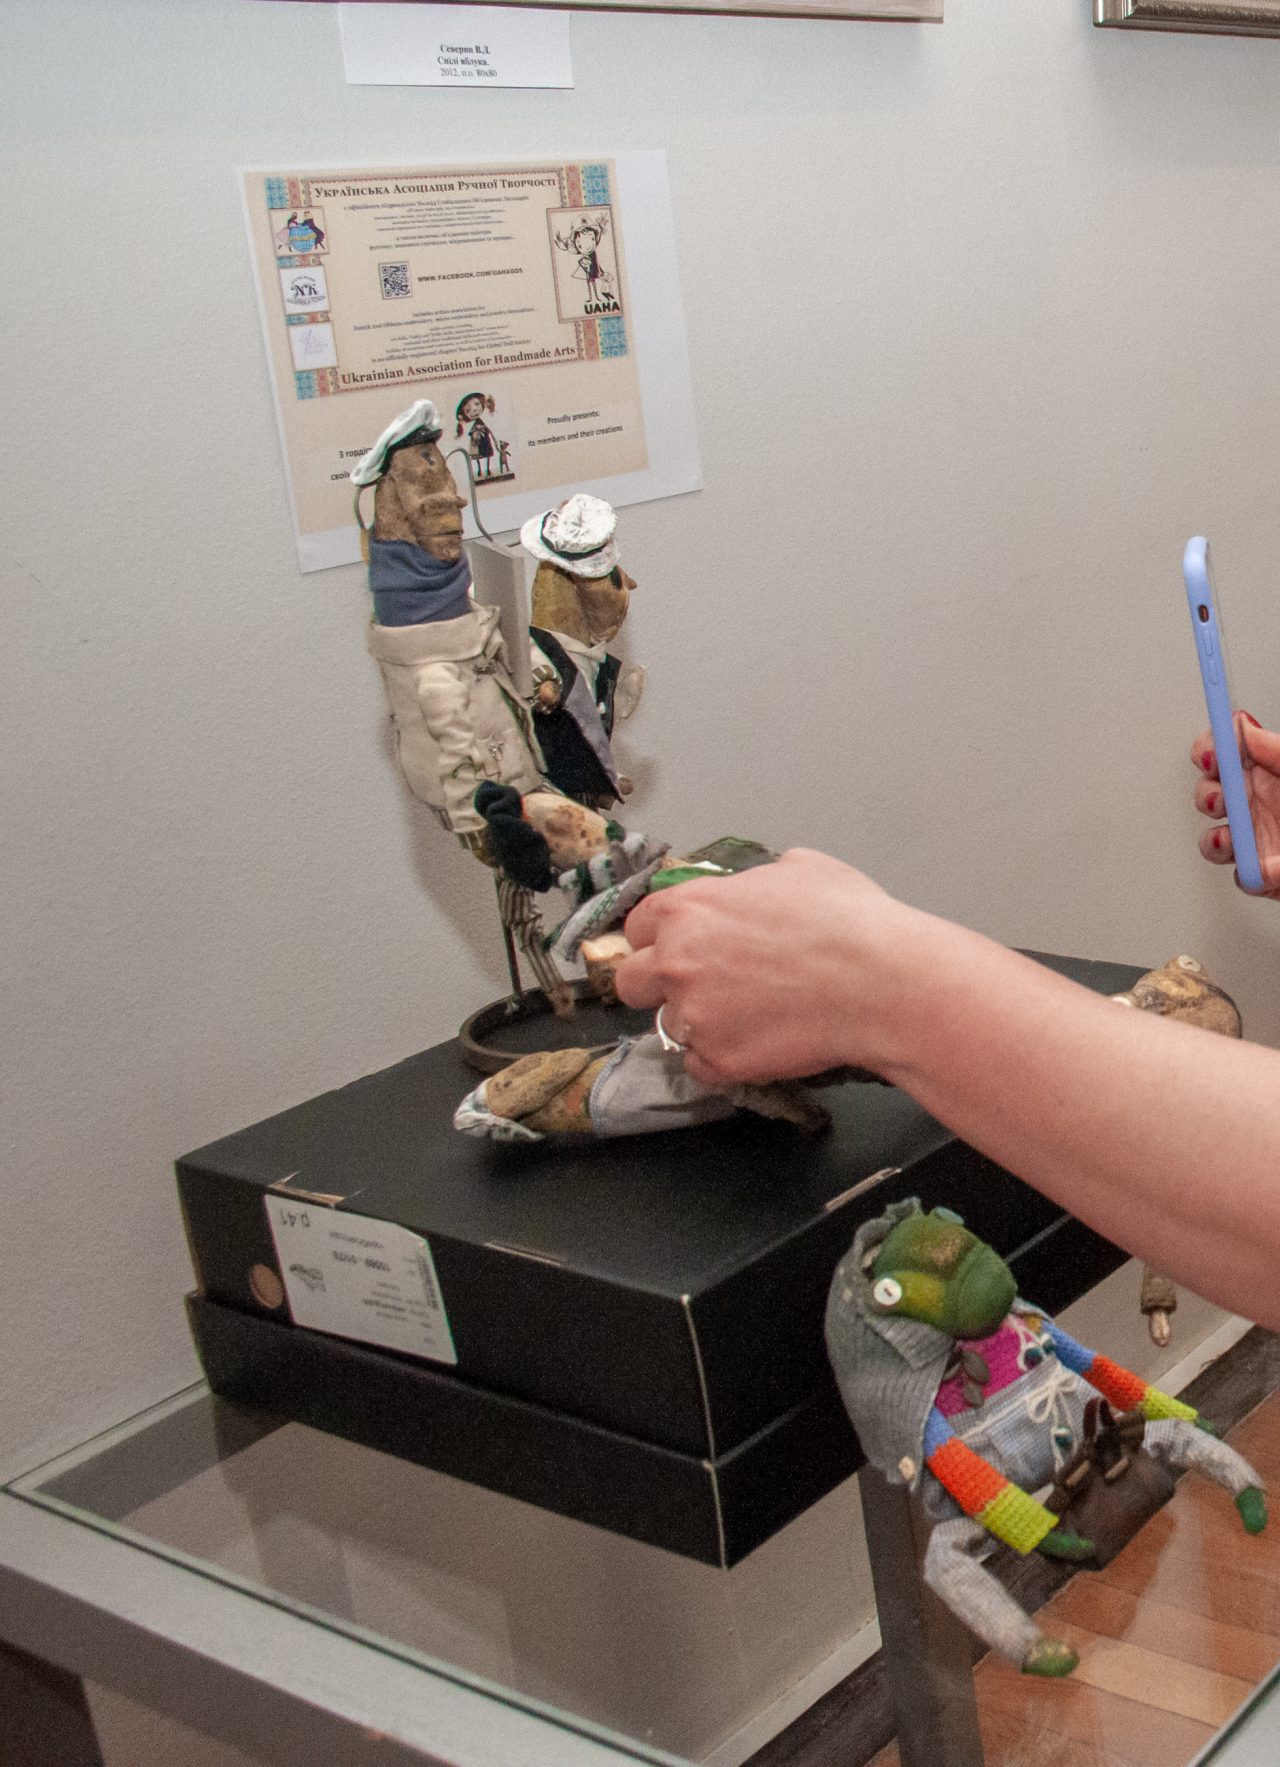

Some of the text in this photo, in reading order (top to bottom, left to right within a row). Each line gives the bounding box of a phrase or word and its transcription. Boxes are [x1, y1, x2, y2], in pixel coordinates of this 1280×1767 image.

[584, 301, 621, 315] UAHA
[341, 346, 576, 385] Ukrainian Association for Handmade Arts
[547, 414, 571, 425] Proudly
[528, 425, 623, 447] its members and their creations
